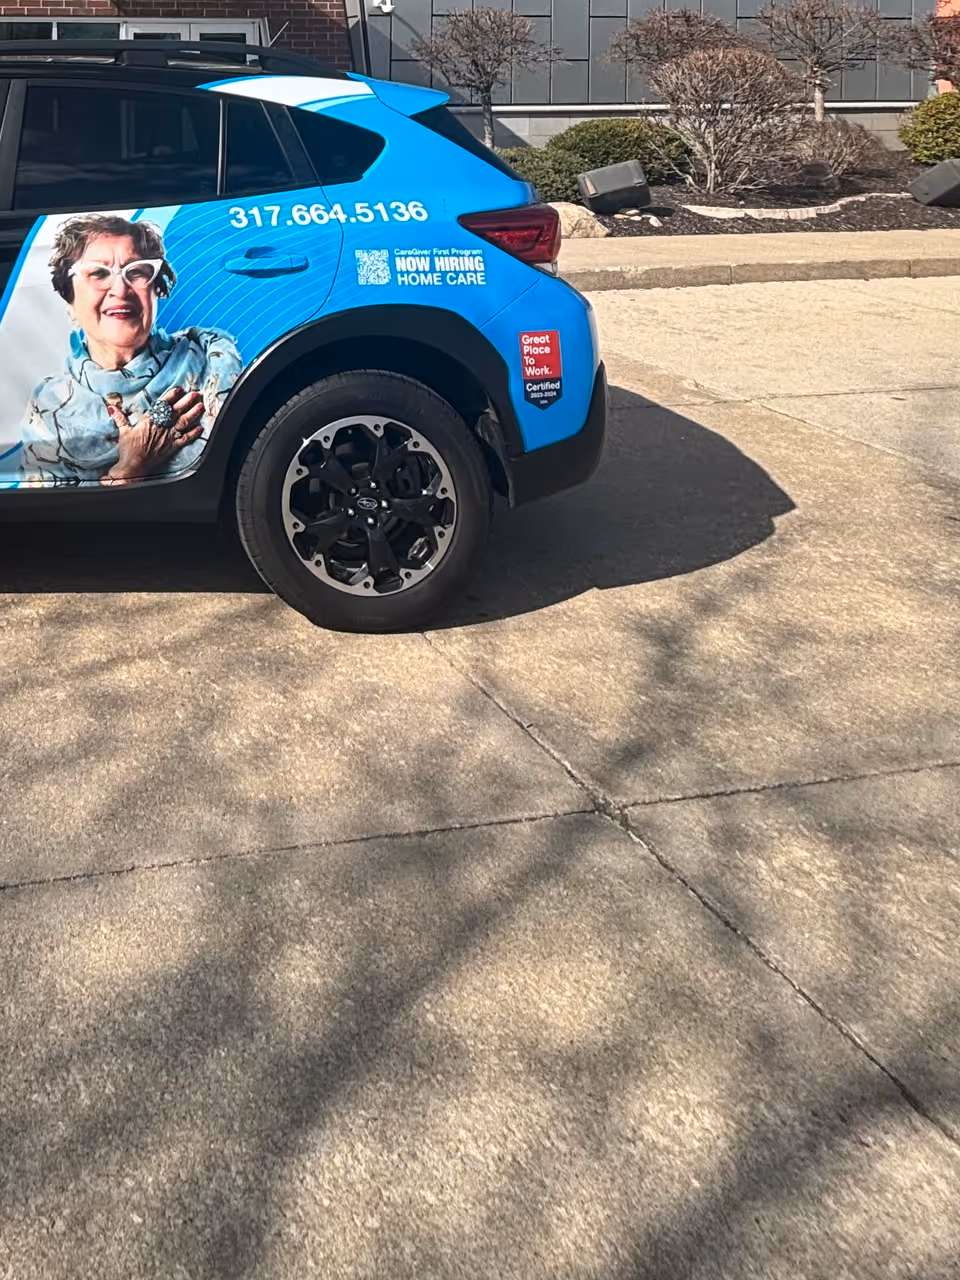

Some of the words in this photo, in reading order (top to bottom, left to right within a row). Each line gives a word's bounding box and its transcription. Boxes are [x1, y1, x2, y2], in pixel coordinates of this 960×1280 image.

[228, 200, 429, 228] 317.664.5136
[451, 248, 482, 257] Program
[395, 256, 430, 272] NOW
[434, 256, 485, 272] HIRING
[397, 273, 442, 285] HOME
[446, 272, 486, 285] CARE
[522, 335, 550, 344] Great
[523, 345, 550, 355] Place
[523, 356, 535, 365] To
[525, 365, 552, 376] Work.
[526, 381, 560, 391] Certified
